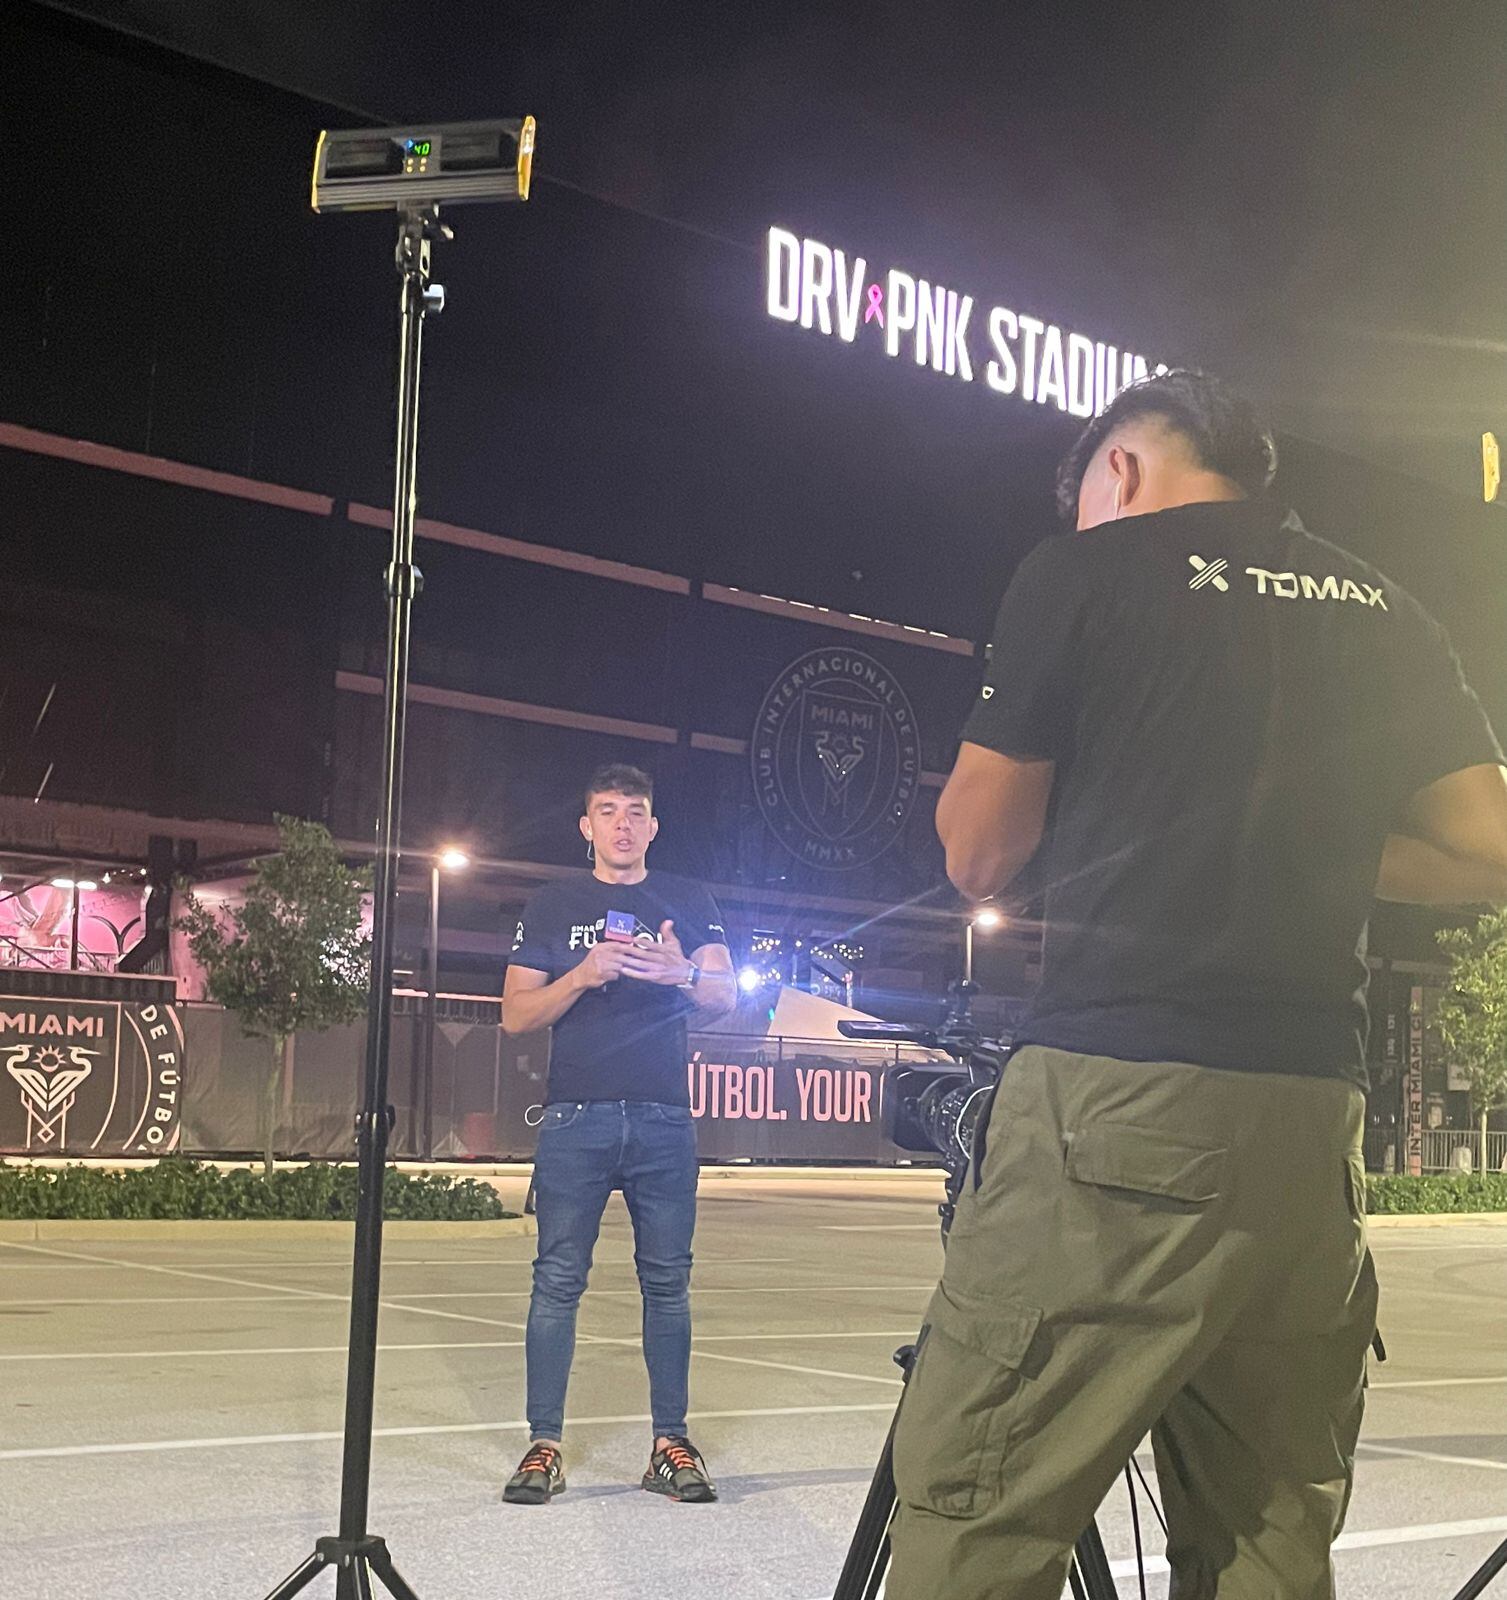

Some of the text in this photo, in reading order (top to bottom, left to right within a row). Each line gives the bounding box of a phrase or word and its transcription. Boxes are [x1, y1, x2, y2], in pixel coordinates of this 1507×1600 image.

[414, 143, 430, 155] 40
[767, 226, 866, 343] DRV
[886, 268, 974, 381] PNK
[1245, 567, 1389, 611] TOMAX
[764, 657, 894, 734] INTERNACIONAL
[811, 704, 873, 730] MIAMI
[895, 708, 912, 736] DE
[760, 748, 778, 806] CLUB
[0, 1011, 104, 1038] MIAMI
[140, 1004, 168, 1040] DE
[1411, 1037, 1421, 1094] MIAMI
[795, 1067, 872, 1123] YOUR
[1411, 1101, 1421, 1156] INTER
